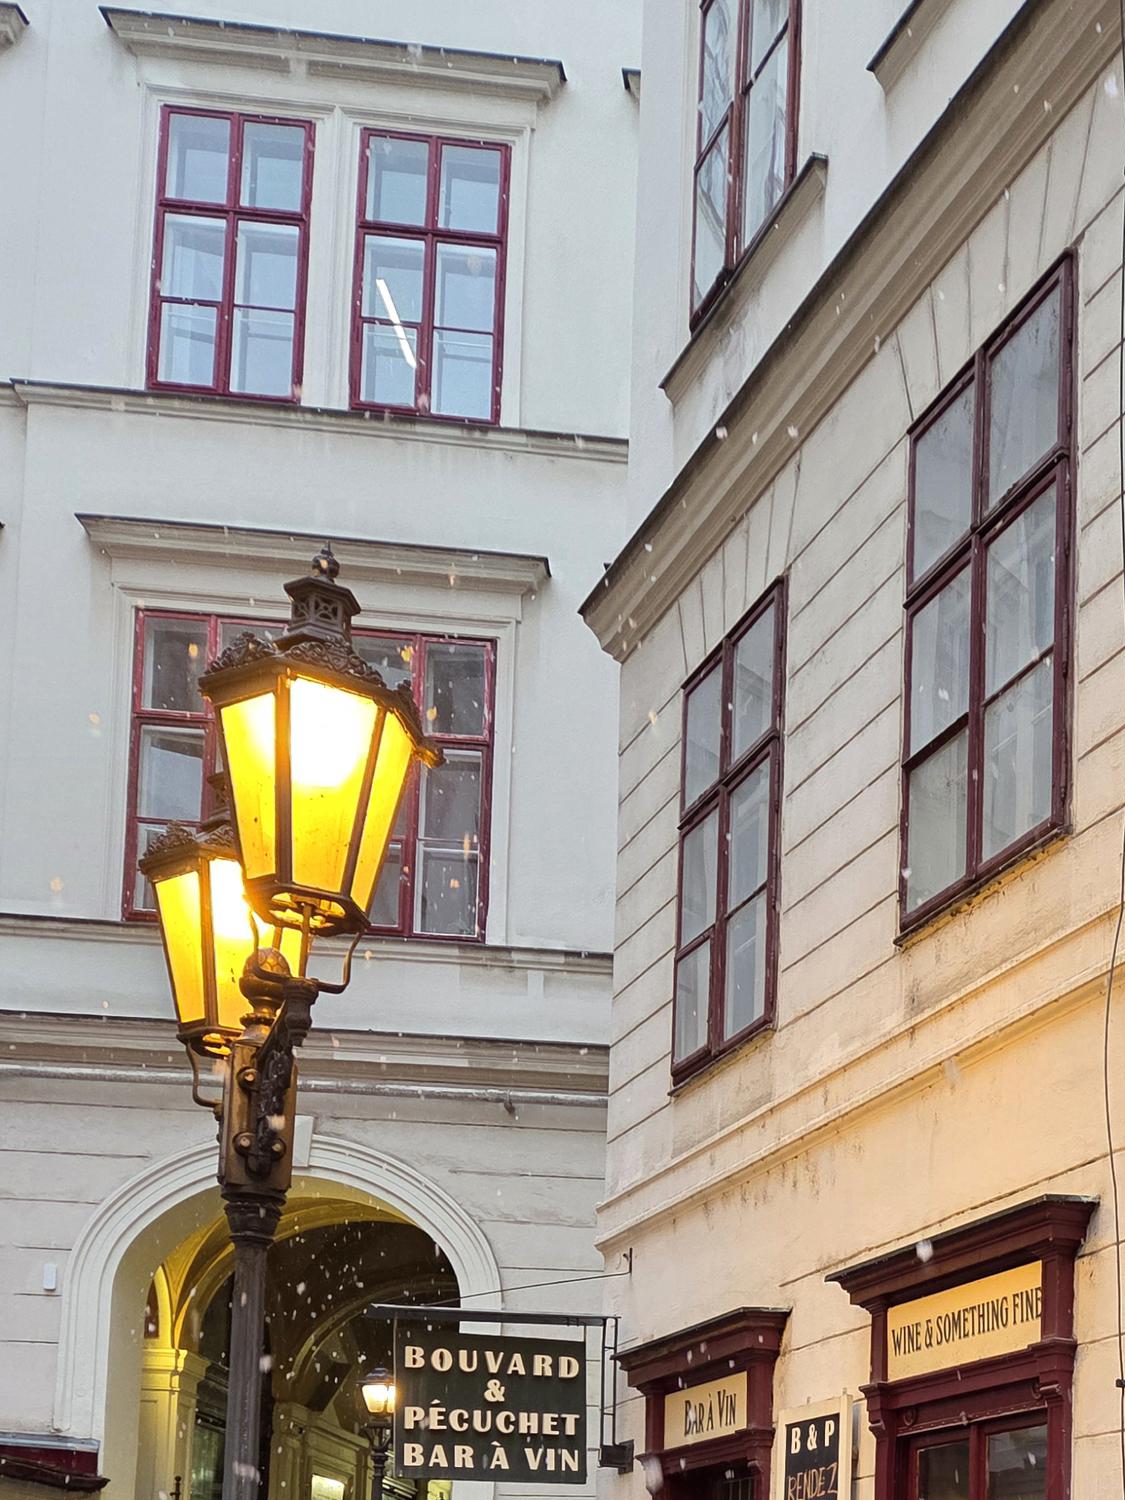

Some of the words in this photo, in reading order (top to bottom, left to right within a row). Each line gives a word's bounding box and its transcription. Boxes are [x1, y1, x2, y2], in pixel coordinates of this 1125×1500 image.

[892, 1320, 922, 1357] WINE
[924, 1318, 934, 1349] &
[936, 1296, 1009, 1346] SOMETHING
[404, 1345, 580, 1379] BOUVARD
[483, 1378, 506, 1403] &
[404, 1399, 580, 1437] PÉCUCHET
[790, 1426, 801, 1455] B
[806, 1423, 818, 1451] &
[824, 1419, 835, 1447] P
[403, 1443, 475, 1469] BAR
[524, 1447, 579, 1472] VIN
